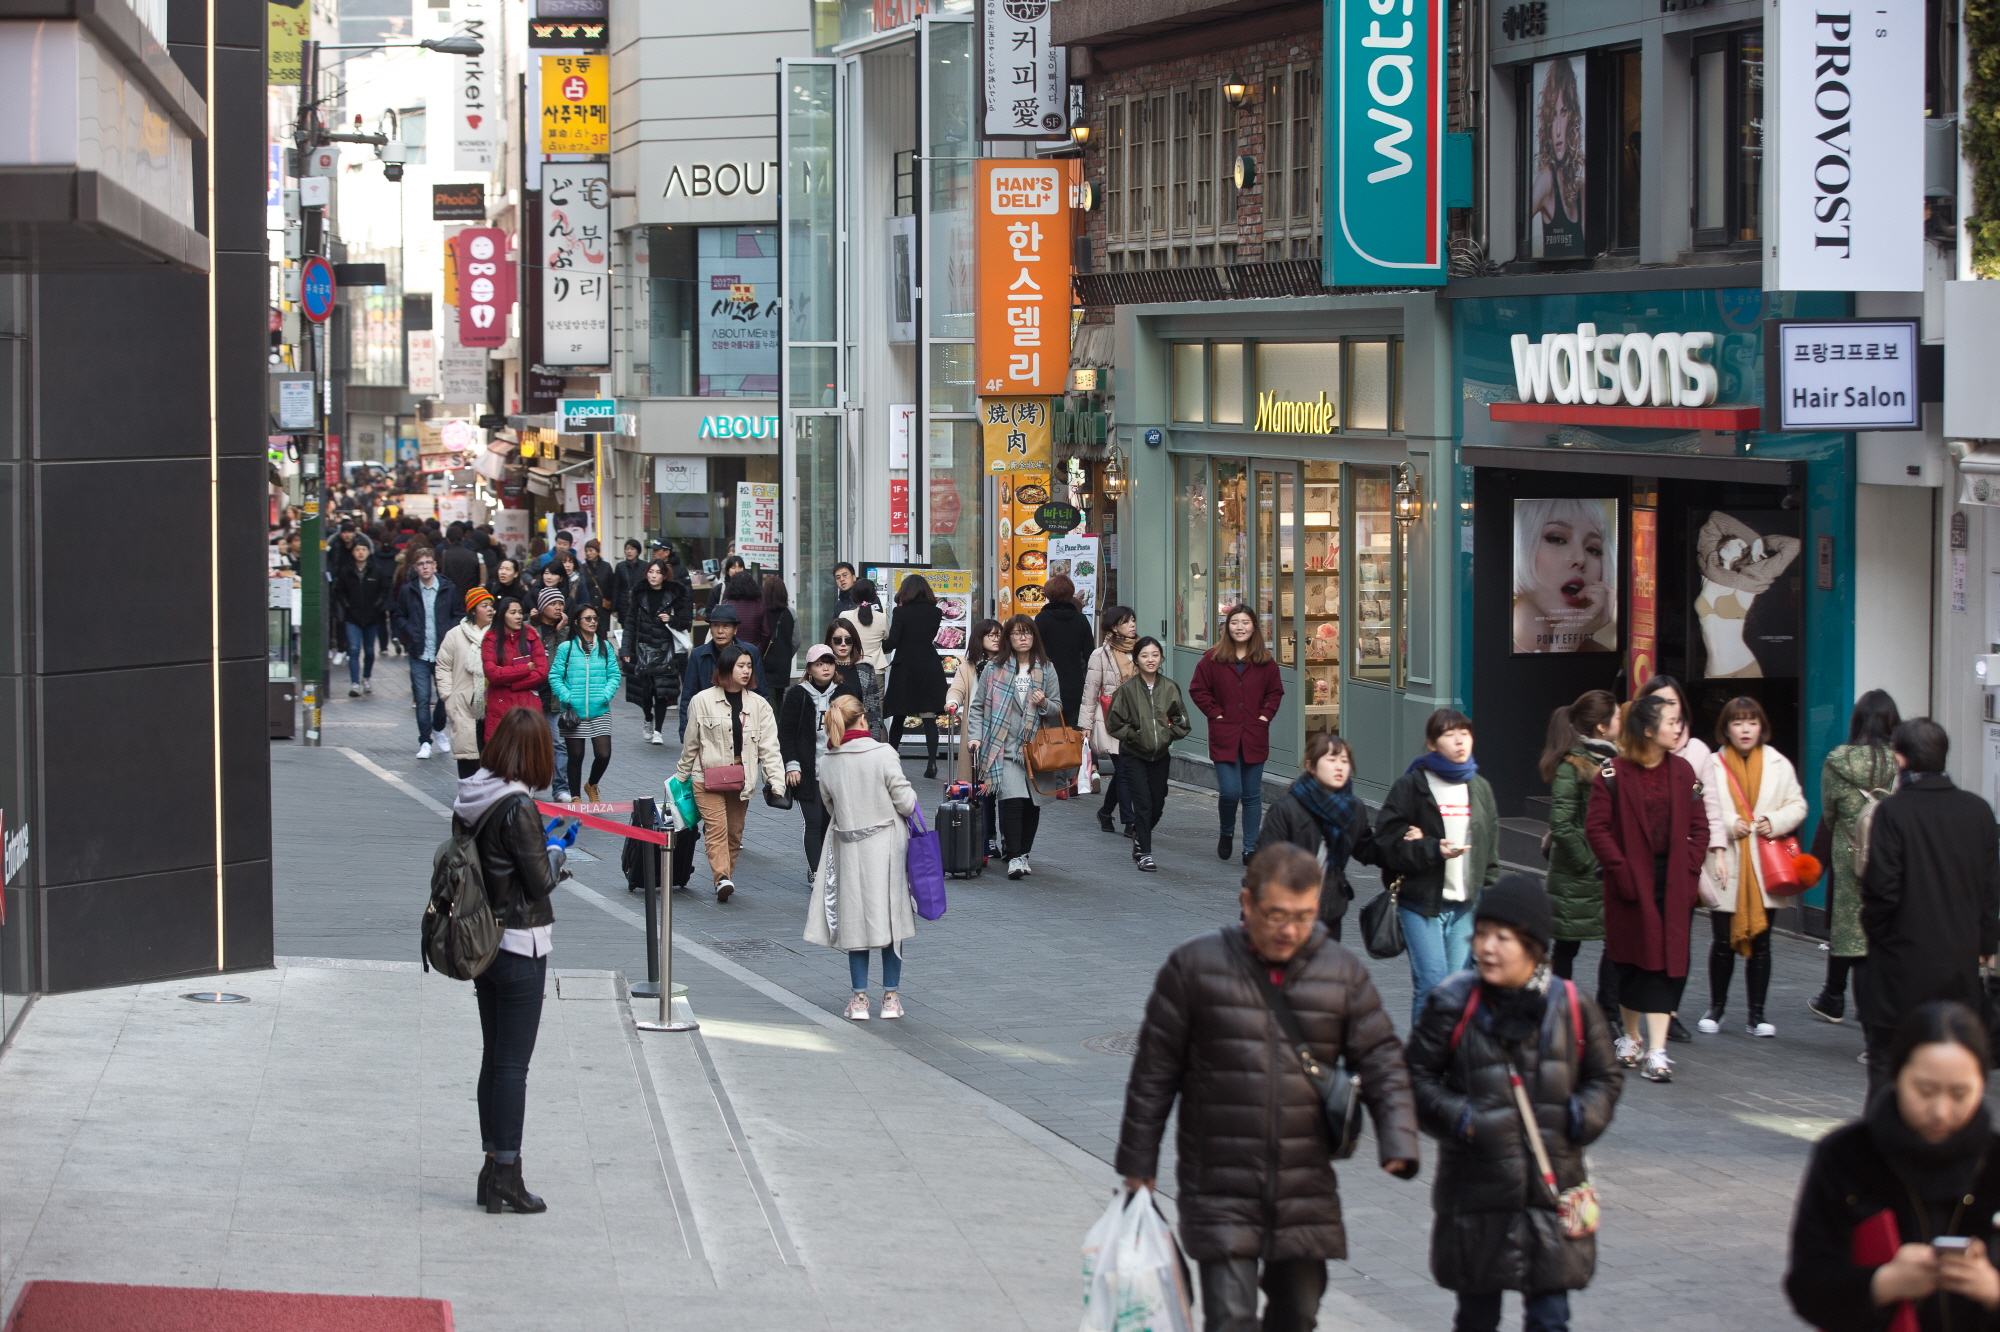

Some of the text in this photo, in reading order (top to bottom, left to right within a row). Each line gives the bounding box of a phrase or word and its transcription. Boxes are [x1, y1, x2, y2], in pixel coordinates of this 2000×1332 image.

[1011, 4, 1041, 19] LOVE
[466, 19, 484, 110] Mrket
[557, 58, 591, 74] 명동
[543, 105, 606, 124] 사주카페
[1046, 117, 1059, 127] 5F
[591, 133, 608, 145] 3F
[1814, 9, 1851, 260] PROVOST
[996, 177, 1053, 191] HAN'S
[549, 178, 574, 302] どんぶり
[578, 177, 603, 302] 돈부리
[1006, 221, 1044, 387] 한스델리
[571, 344, 582, 352] 2F
[1794, 342, 1899, 364] 프랑크프로보
[1510, 322, 1718, 407] watsons
[540, 377, 560, 386] hair
[985, 378, 1003, 391] 4F
[1792, 385, 1906, 409] Hair Salon
[568, 406, 613, 417] ABOUT
[1254, 389, 1336, 435] Mamonde
[1006, 429, 1028, 455] 肉
[666, 465, 688, 475] beauty
[666, 466, 698, 491] self
[754, 497, 774, 544] 부대찌개
[1044, 508, 1073, 519] 빠네
[1536, 634, 1560, 645] PONY
[580, 803, 614, 813] PLAZA
